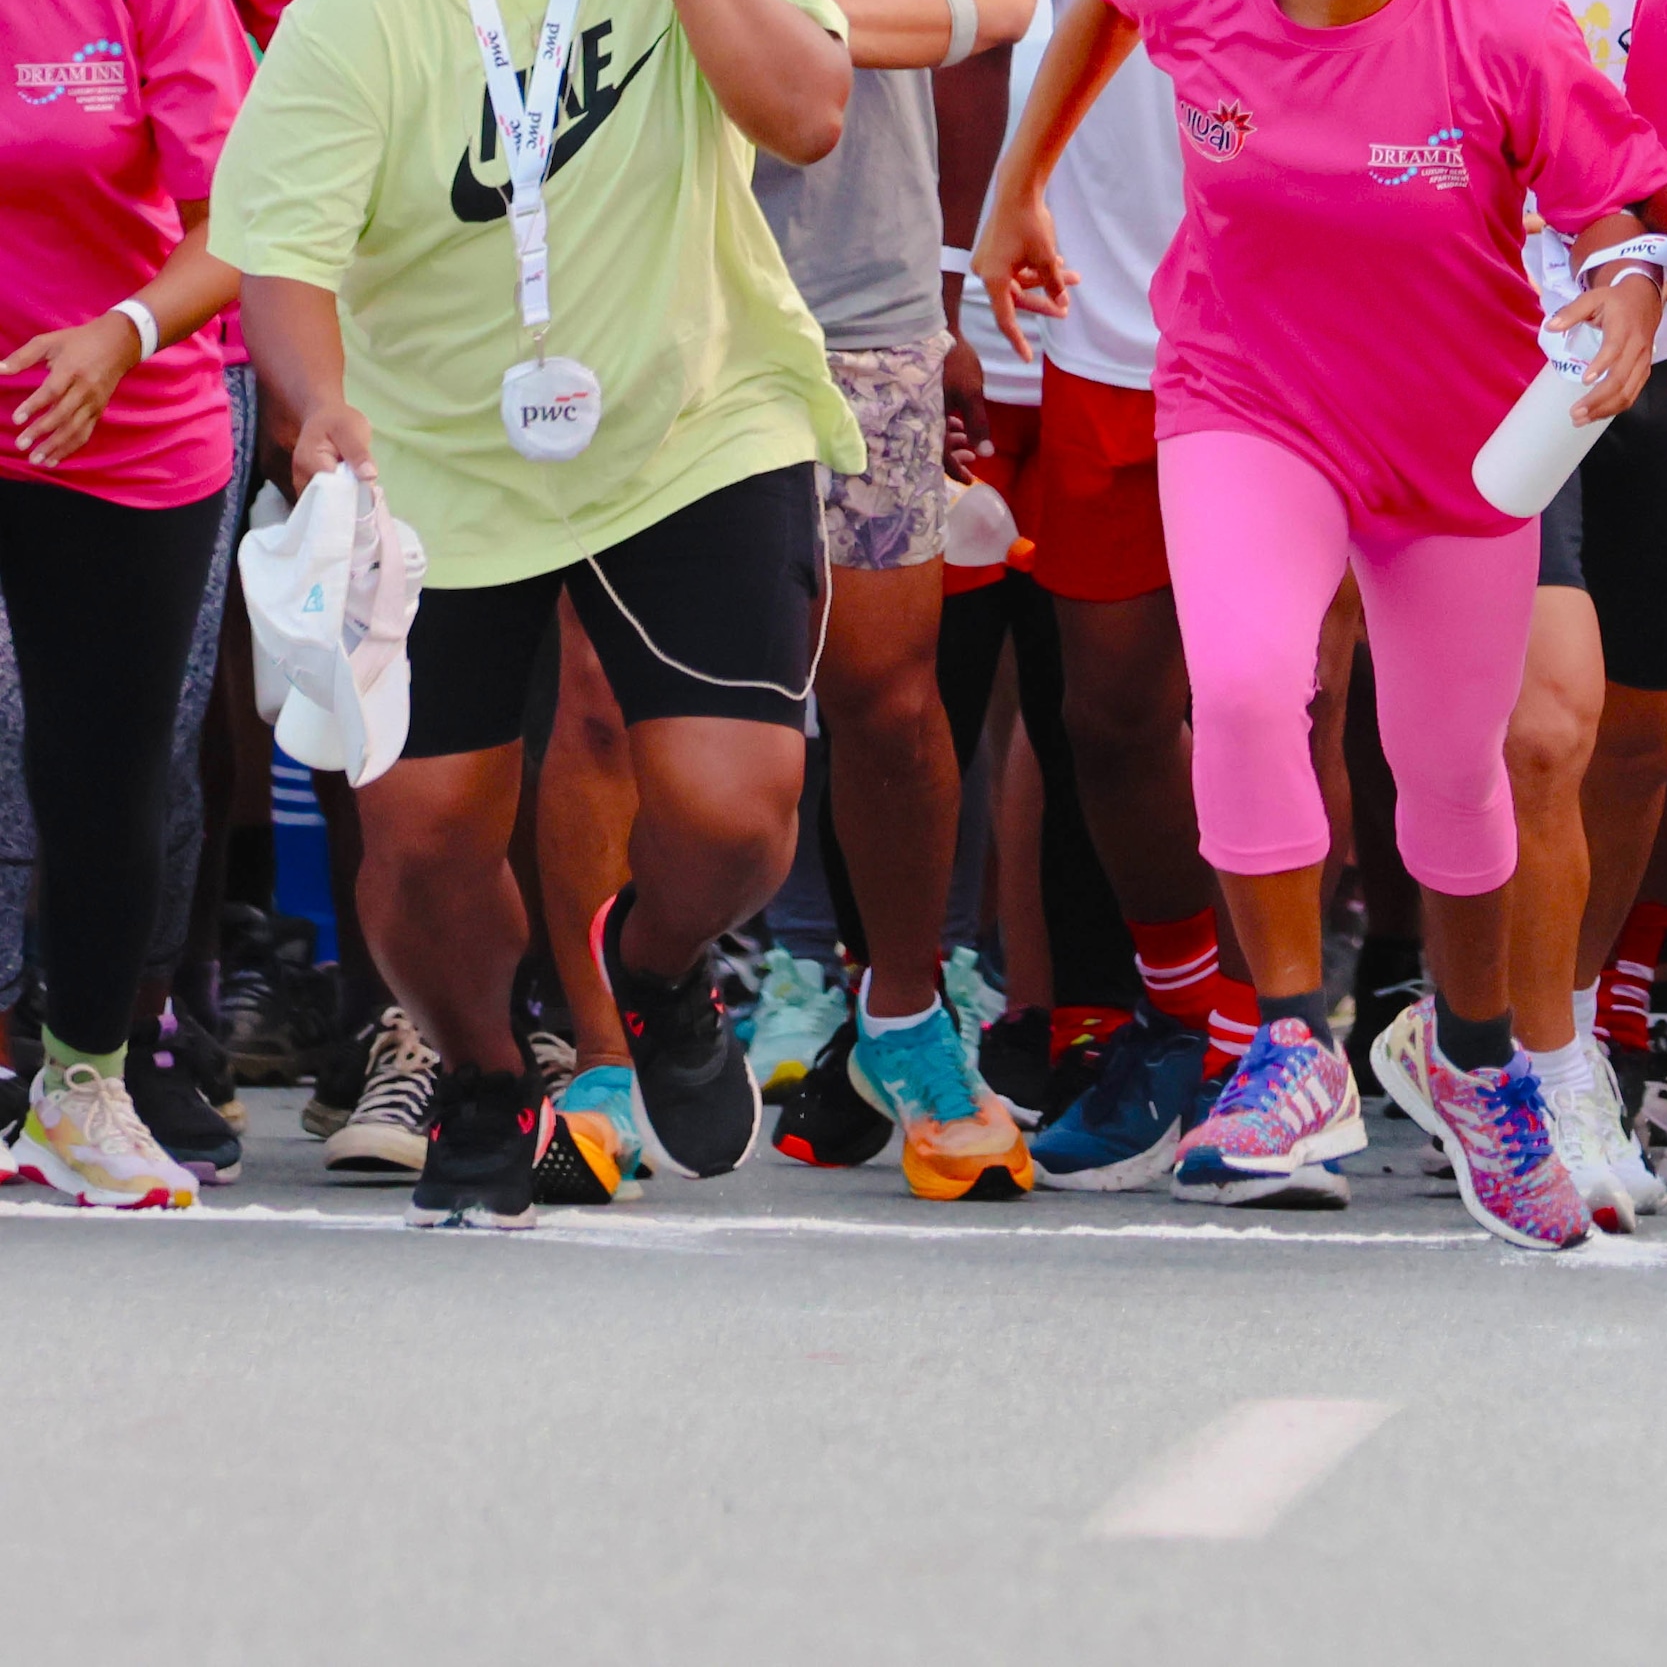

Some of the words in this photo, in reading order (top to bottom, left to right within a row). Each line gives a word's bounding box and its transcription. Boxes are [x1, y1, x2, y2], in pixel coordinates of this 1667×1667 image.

[487, 30, 509, 69] pwc
[542, 22, 560, 60] pwc
[17, 65, 86, 84] DREAM
[90, 63, 124, 82] INN
[526, 110, 543, 150] pwc
[1371, 148, 1438, 166] DREAM
[1621, 242, 1657, 256] pwc
[521, 405, 578, 428] pwc
